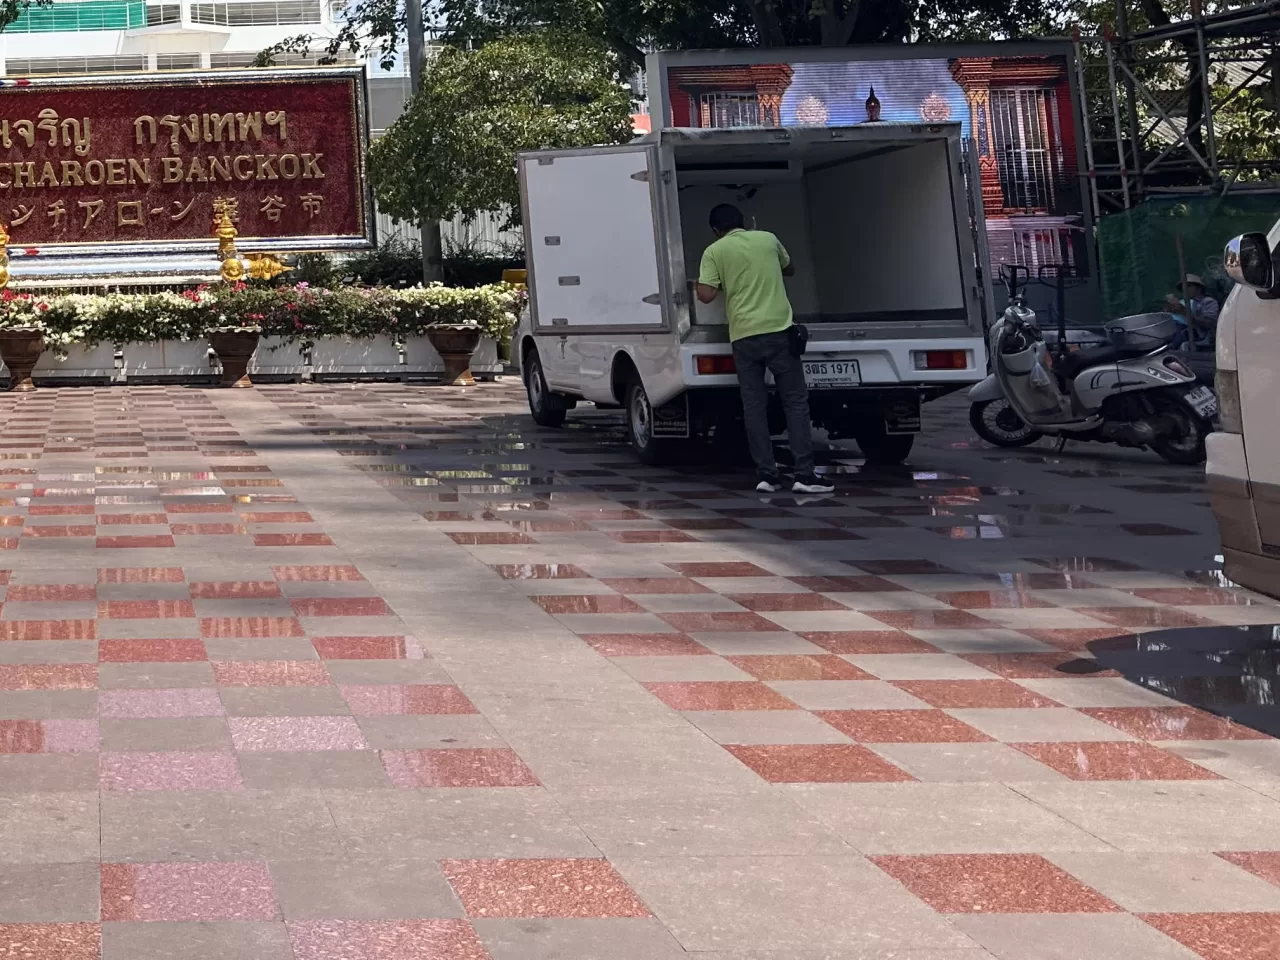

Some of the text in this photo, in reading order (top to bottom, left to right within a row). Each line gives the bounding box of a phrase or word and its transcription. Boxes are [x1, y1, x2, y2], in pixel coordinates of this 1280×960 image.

[133, 110, 287, 155] กรุงเทพฯ
[162, 153, 326, 184] BANGKOK
[830, 363, 856, 374] 1971
